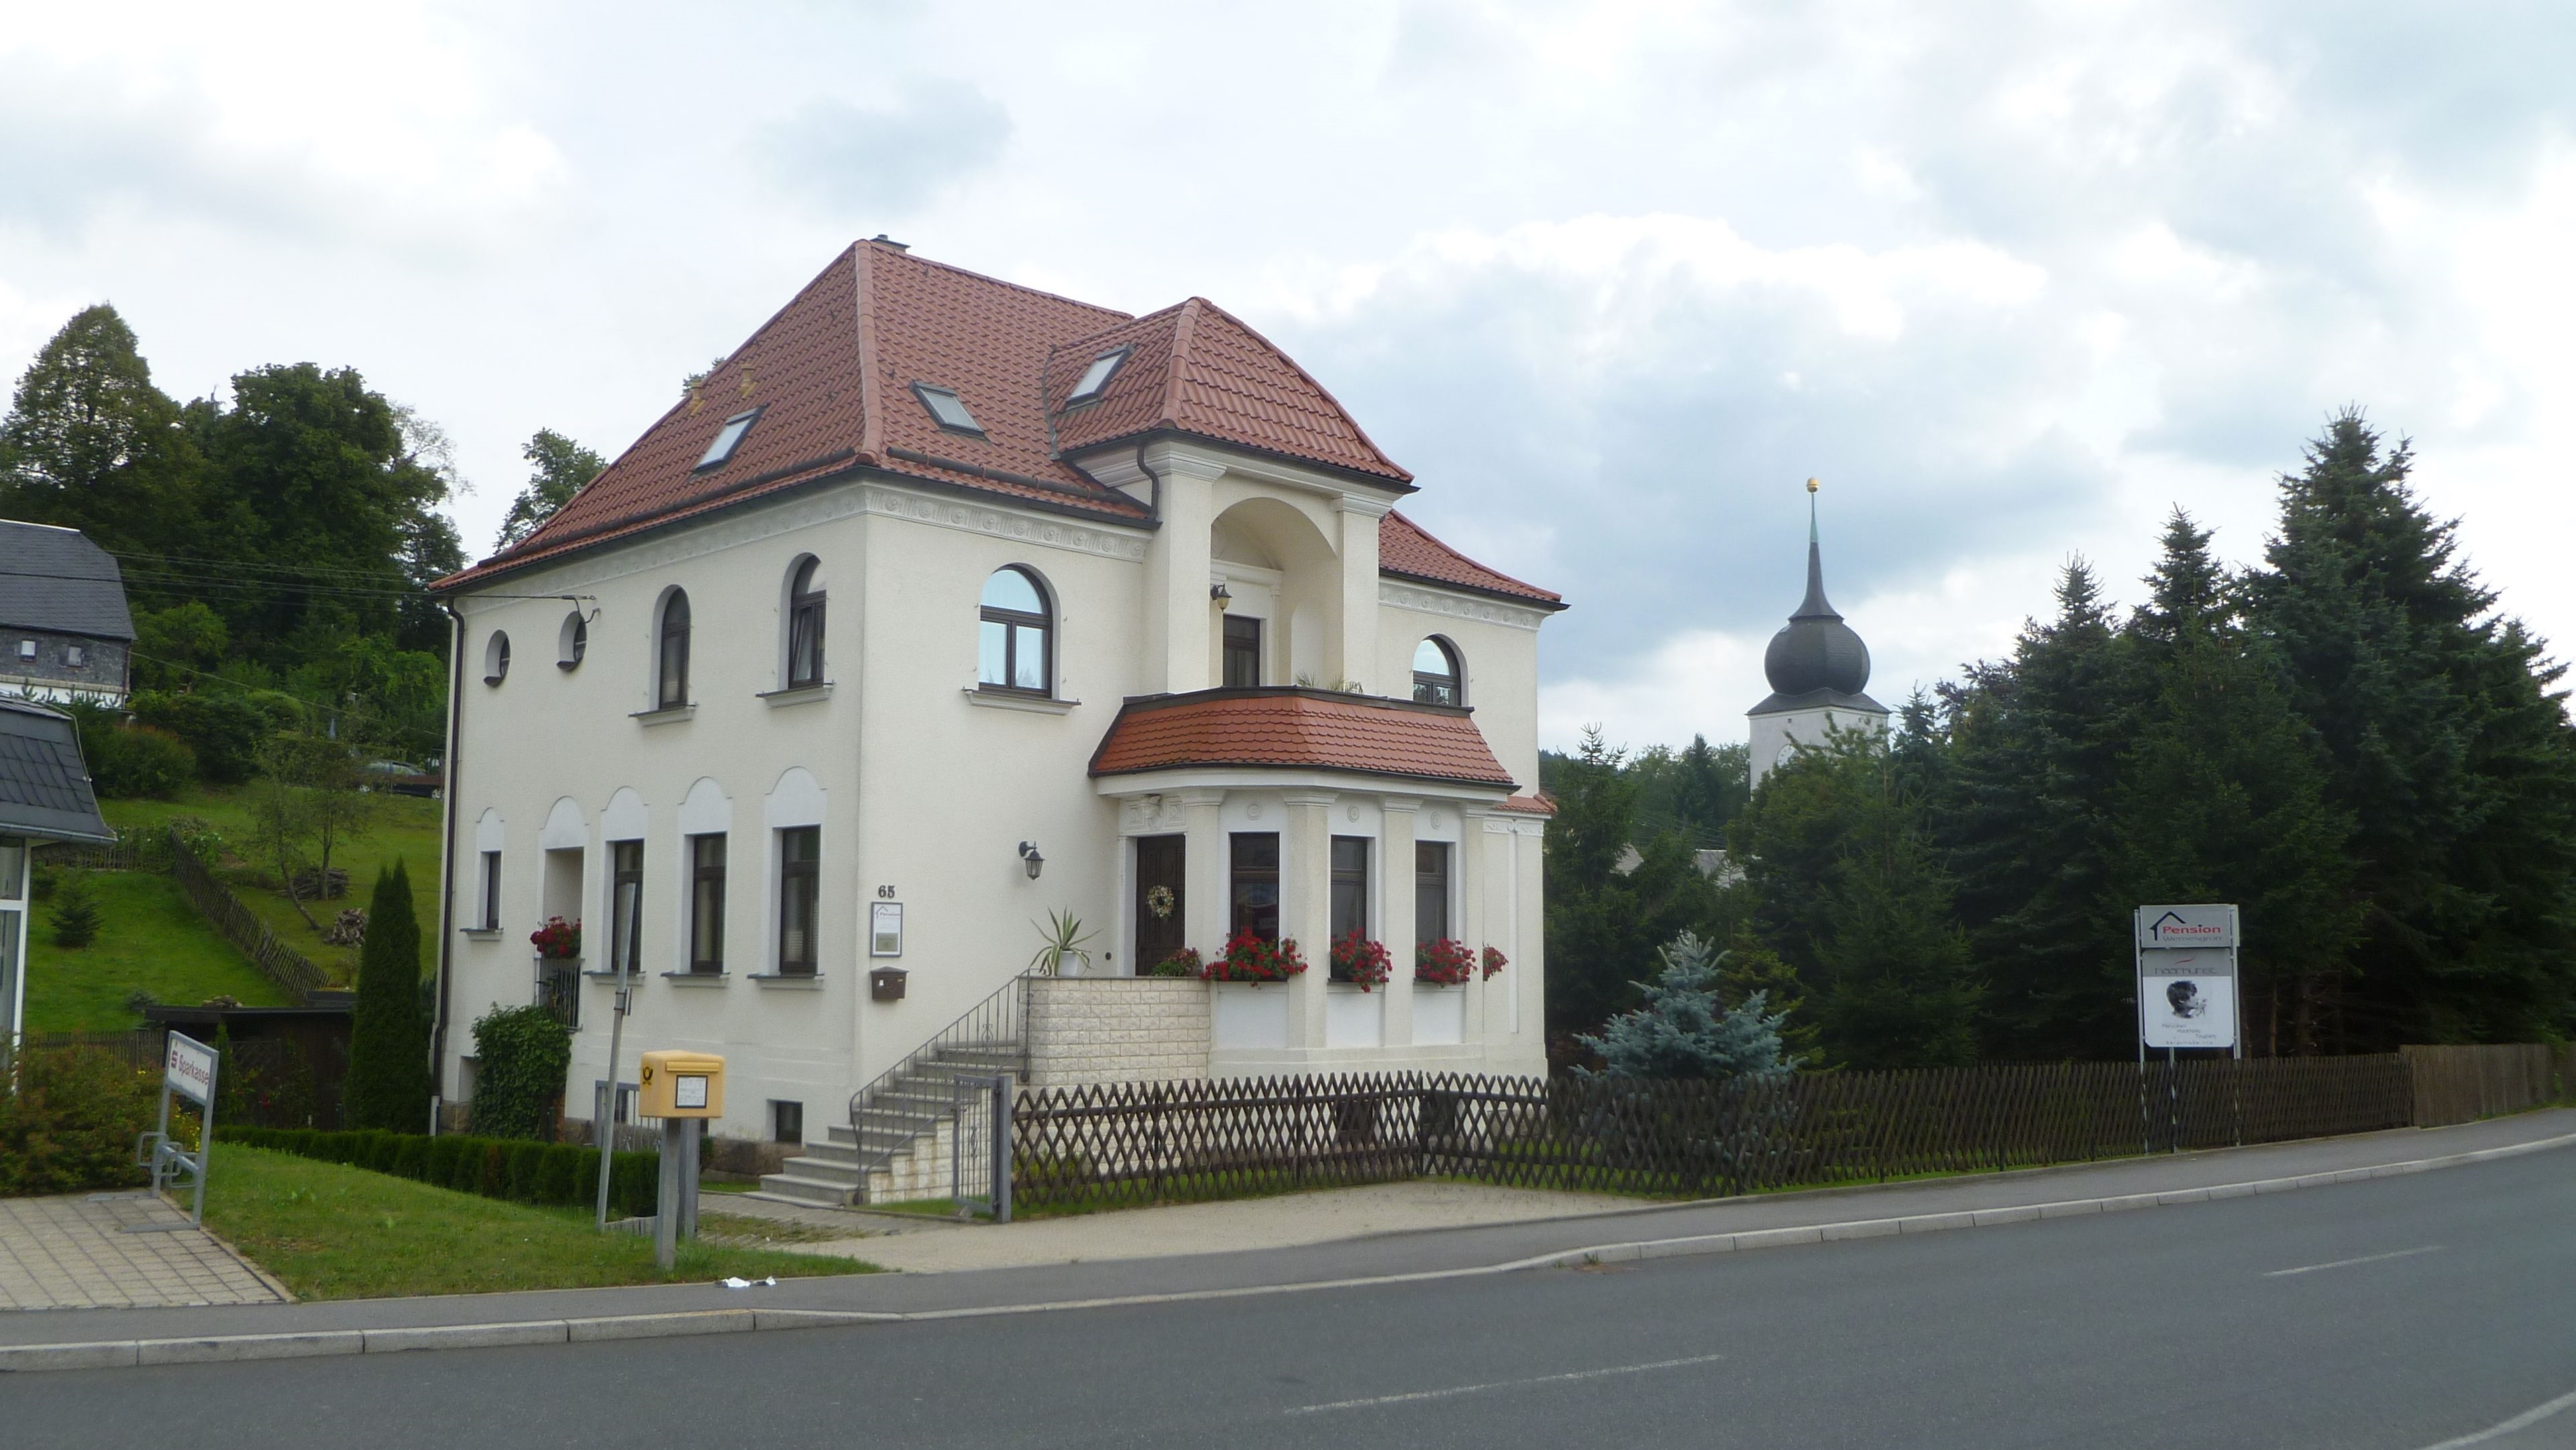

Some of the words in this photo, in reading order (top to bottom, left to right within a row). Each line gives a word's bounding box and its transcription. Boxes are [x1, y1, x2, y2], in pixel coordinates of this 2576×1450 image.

[878, 885, 896, 898] 65
[2162, 924, 2222, 934] Pension
[178, 1054, 209, 1085] Sparkasse
